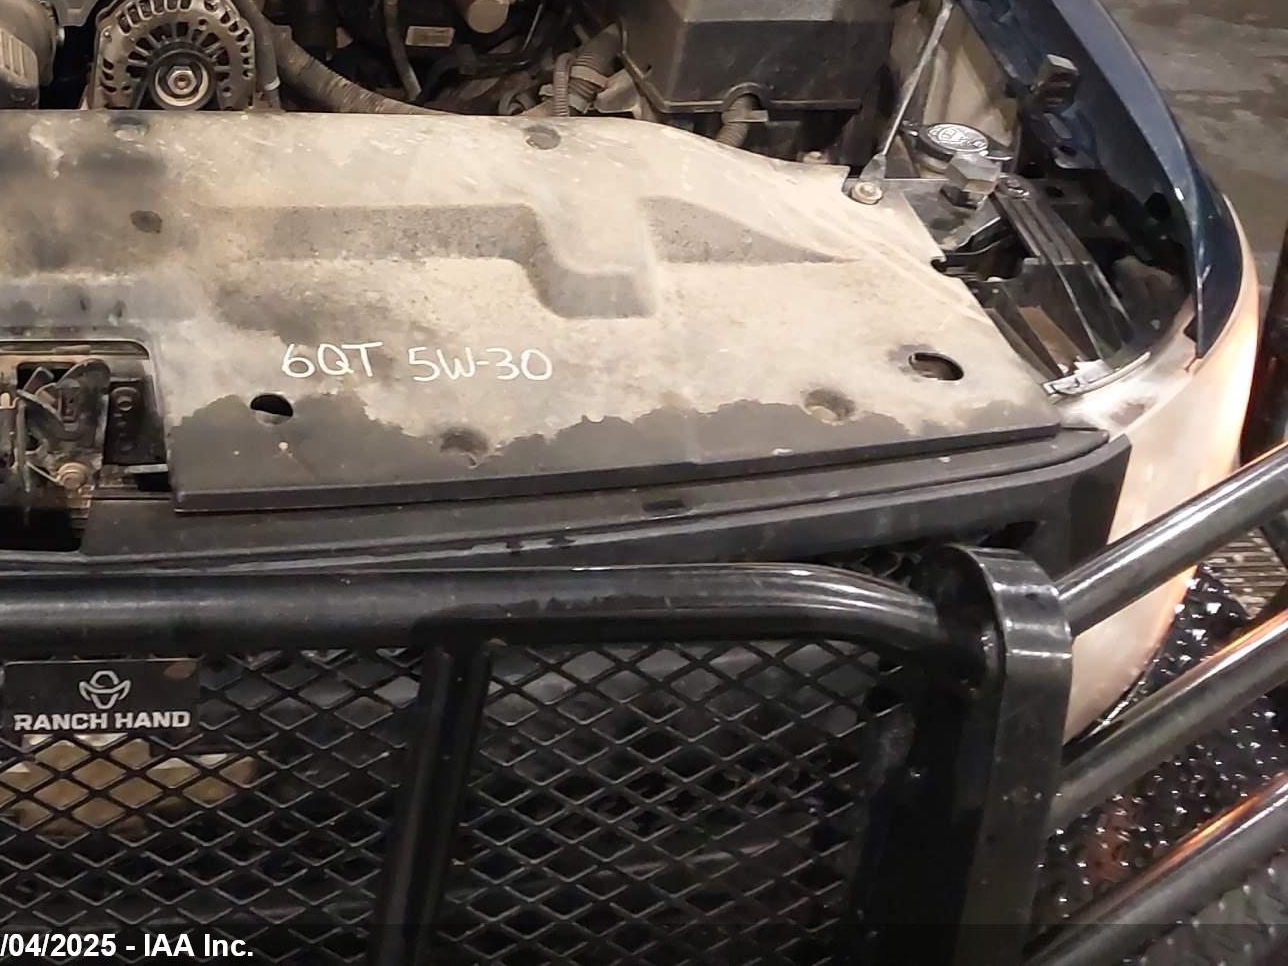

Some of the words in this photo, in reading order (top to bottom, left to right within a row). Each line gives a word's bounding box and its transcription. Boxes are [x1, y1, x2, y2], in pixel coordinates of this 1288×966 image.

[281, 341, 383, 378] 6QT
[407, 346, 553, 381] 5W-30
[13, 713, 108, 731] RANCH
[114, 711, 191, 728] HAND
